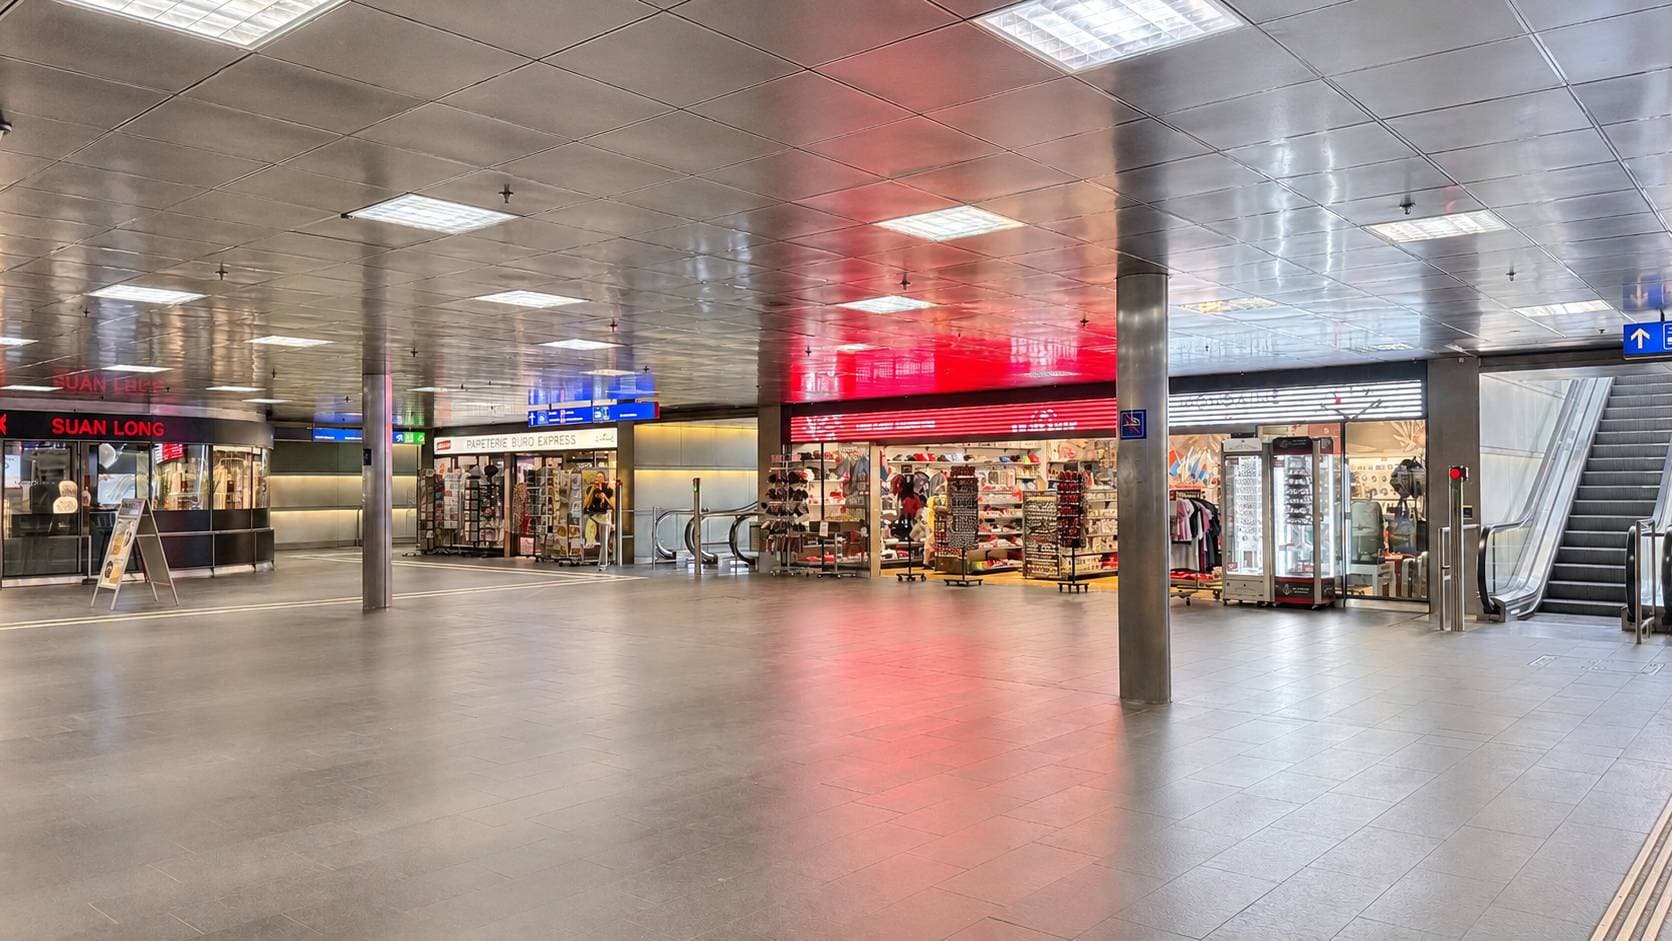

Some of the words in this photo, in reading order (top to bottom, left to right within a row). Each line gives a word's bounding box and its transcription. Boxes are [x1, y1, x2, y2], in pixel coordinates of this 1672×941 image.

[52, 417, 107, 435] SUAN
[113, 420, 165, 437] LONG
[467, 438, 508, 449] PAPETERIE
[538, 435, 577, 447] EXPRESS
